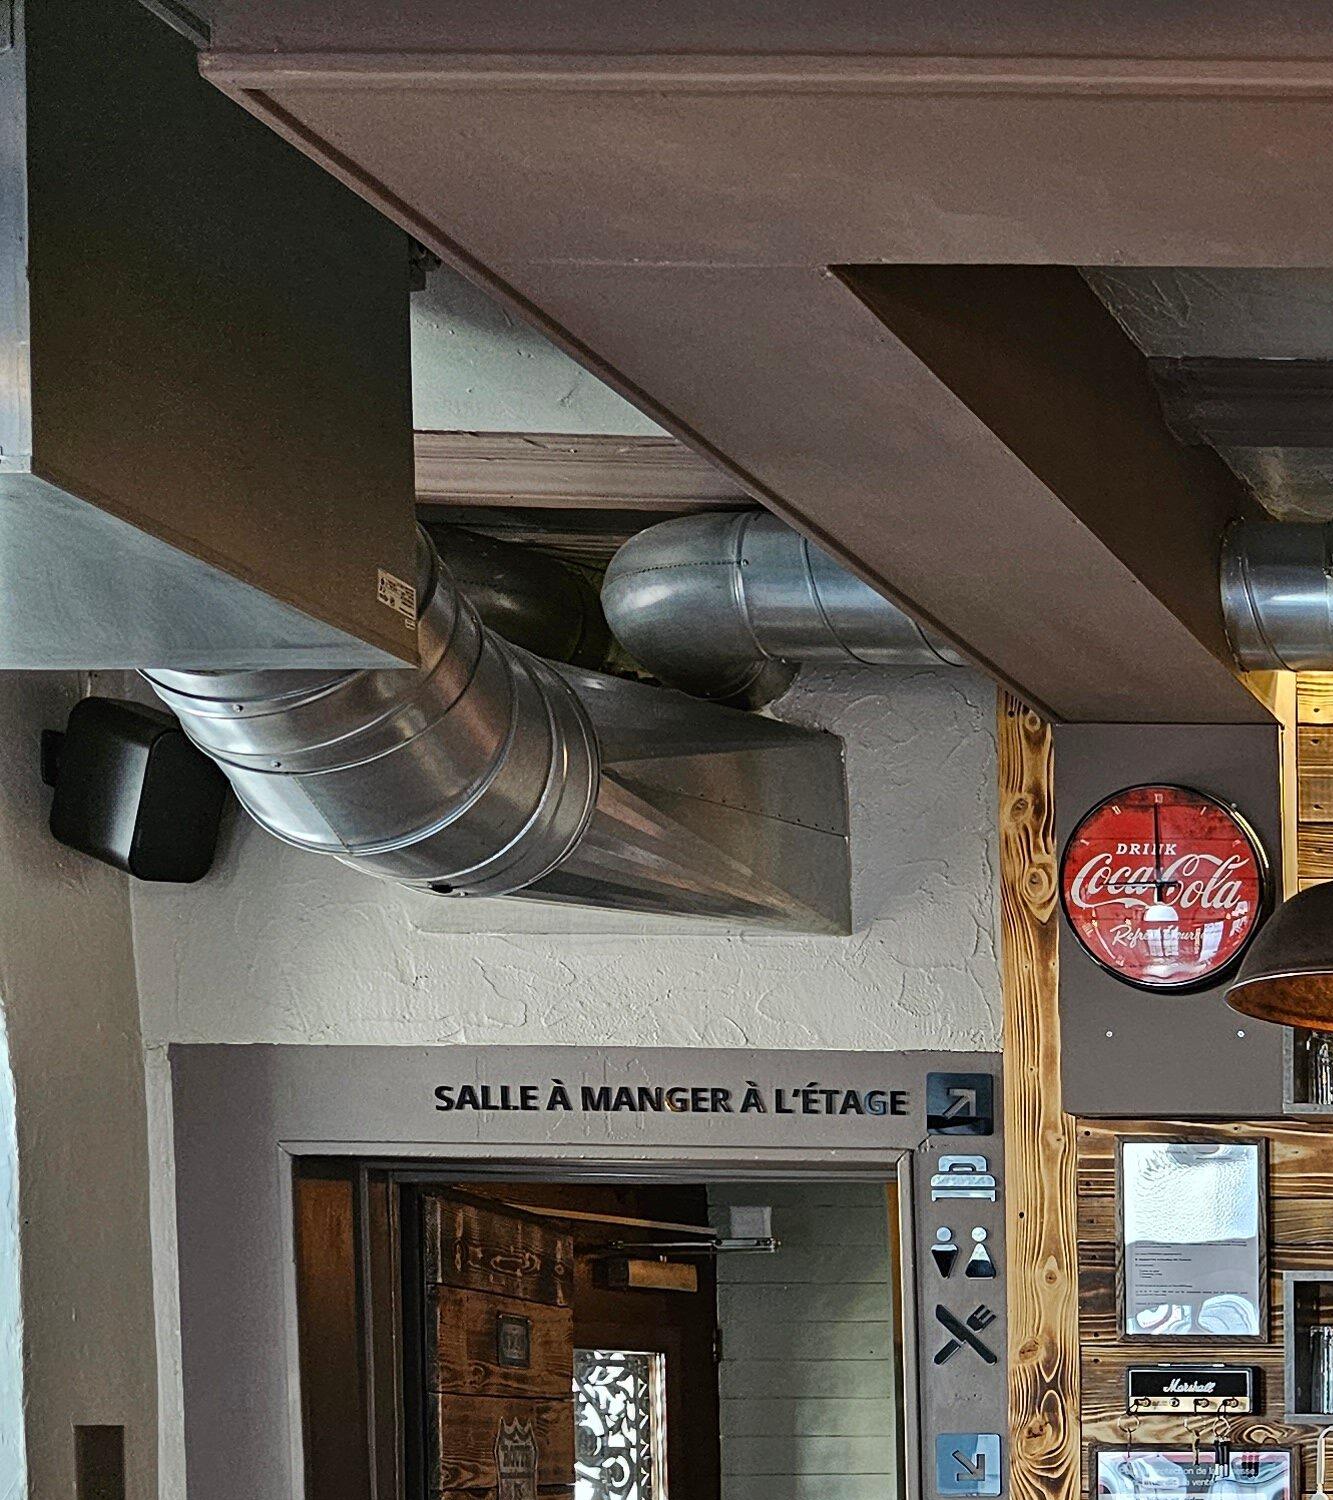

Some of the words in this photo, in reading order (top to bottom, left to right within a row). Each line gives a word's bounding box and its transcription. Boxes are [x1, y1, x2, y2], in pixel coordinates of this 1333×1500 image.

[1071, 853, 1249, 910] Coca-Cola
[434, 1084, 539, 1111] SALLE
[546, 1078, 572, 1111] À
[581, 1085, 731, 1114] MANGER
[740, 1080, 766, 1114] À
[775, 1082, 909, 1116] L'ÉTAGE
[1163, 1377, 1217, 1393] Marshall
